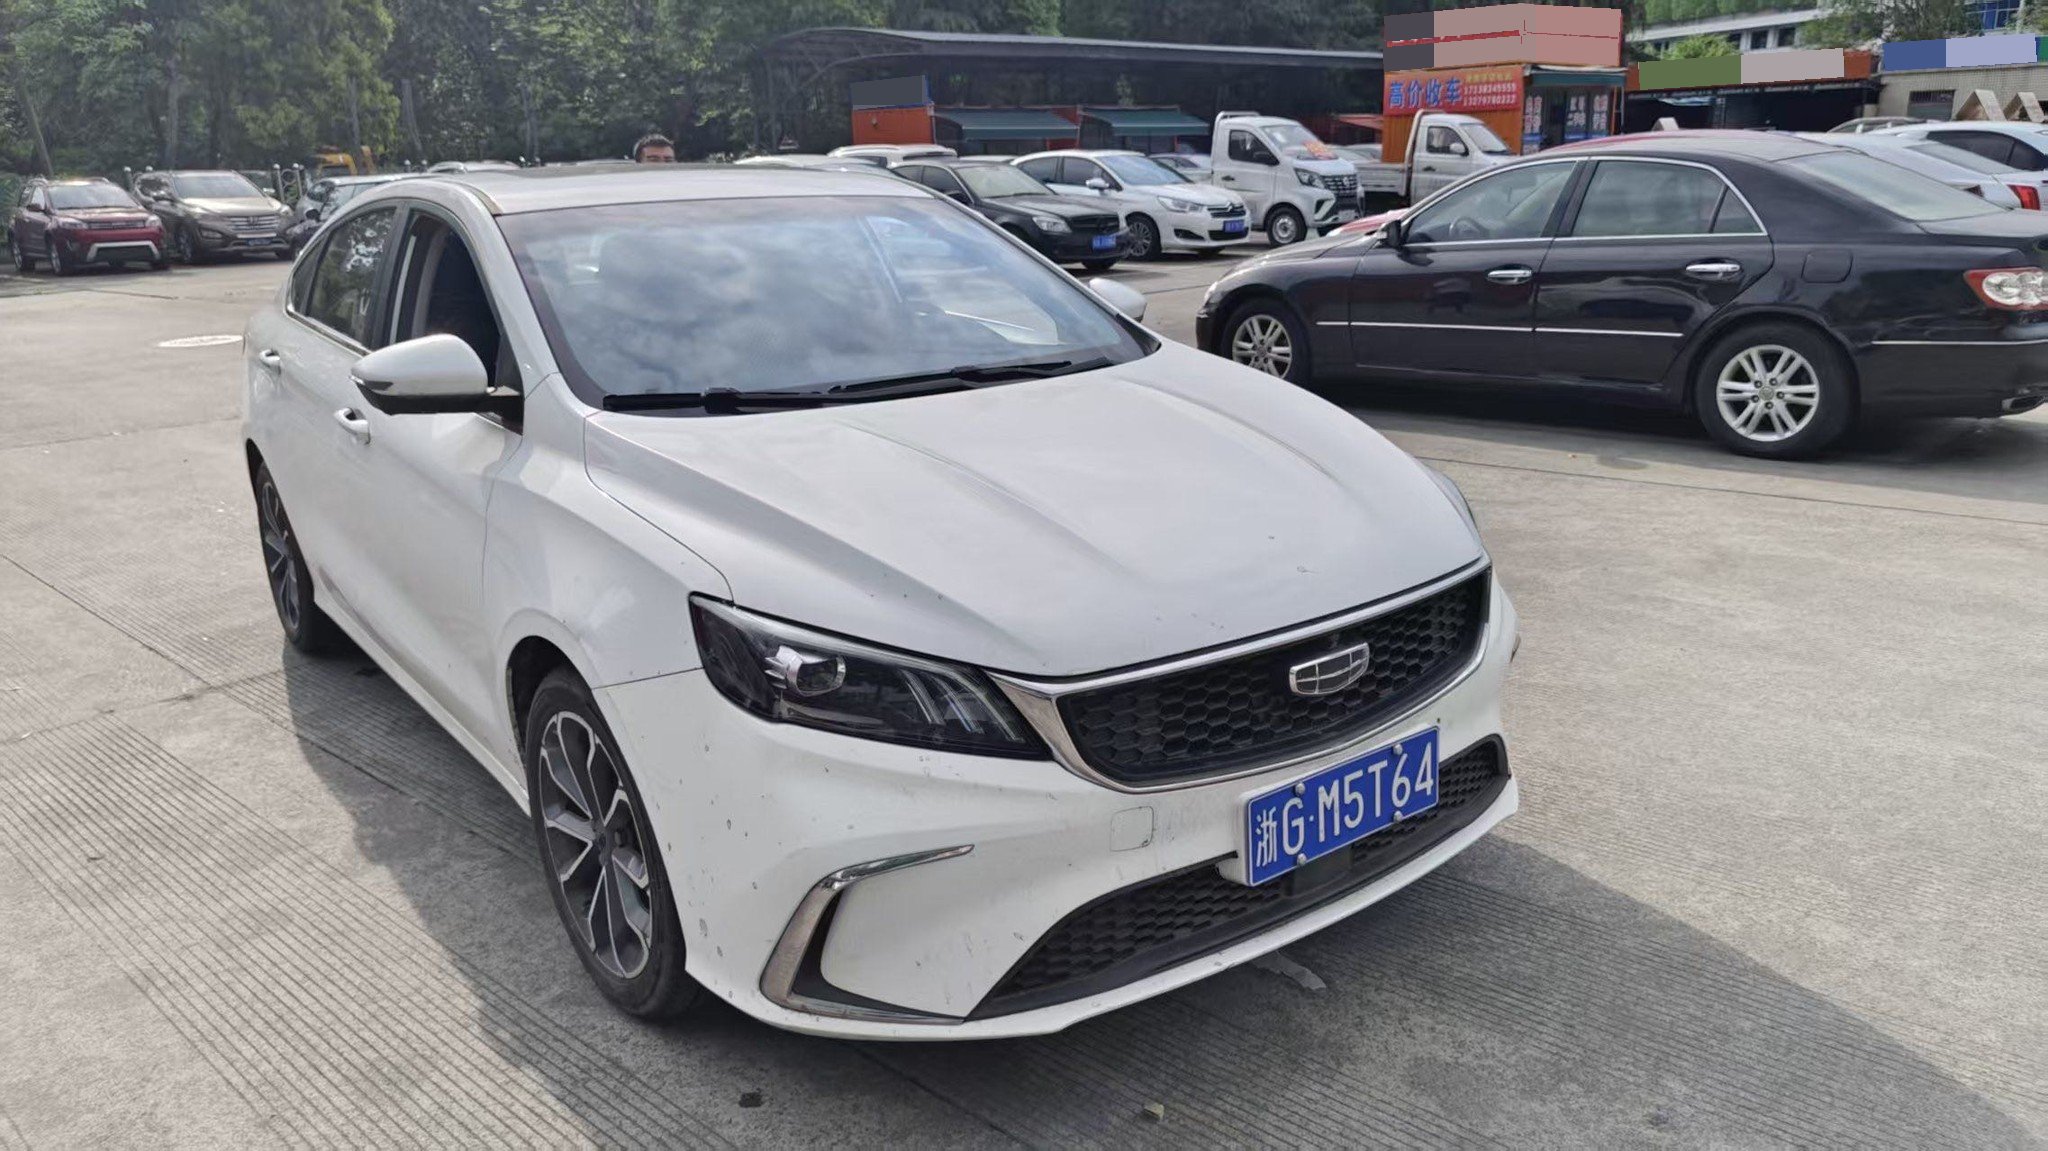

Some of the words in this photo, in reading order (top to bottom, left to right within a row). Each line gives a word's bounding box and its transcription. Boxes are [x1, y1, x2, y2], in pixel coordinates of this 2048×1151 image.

[1389, 79, 1462, 108] 高价收车
[1256, 742, 1434, 867] 浙G·M5T64
